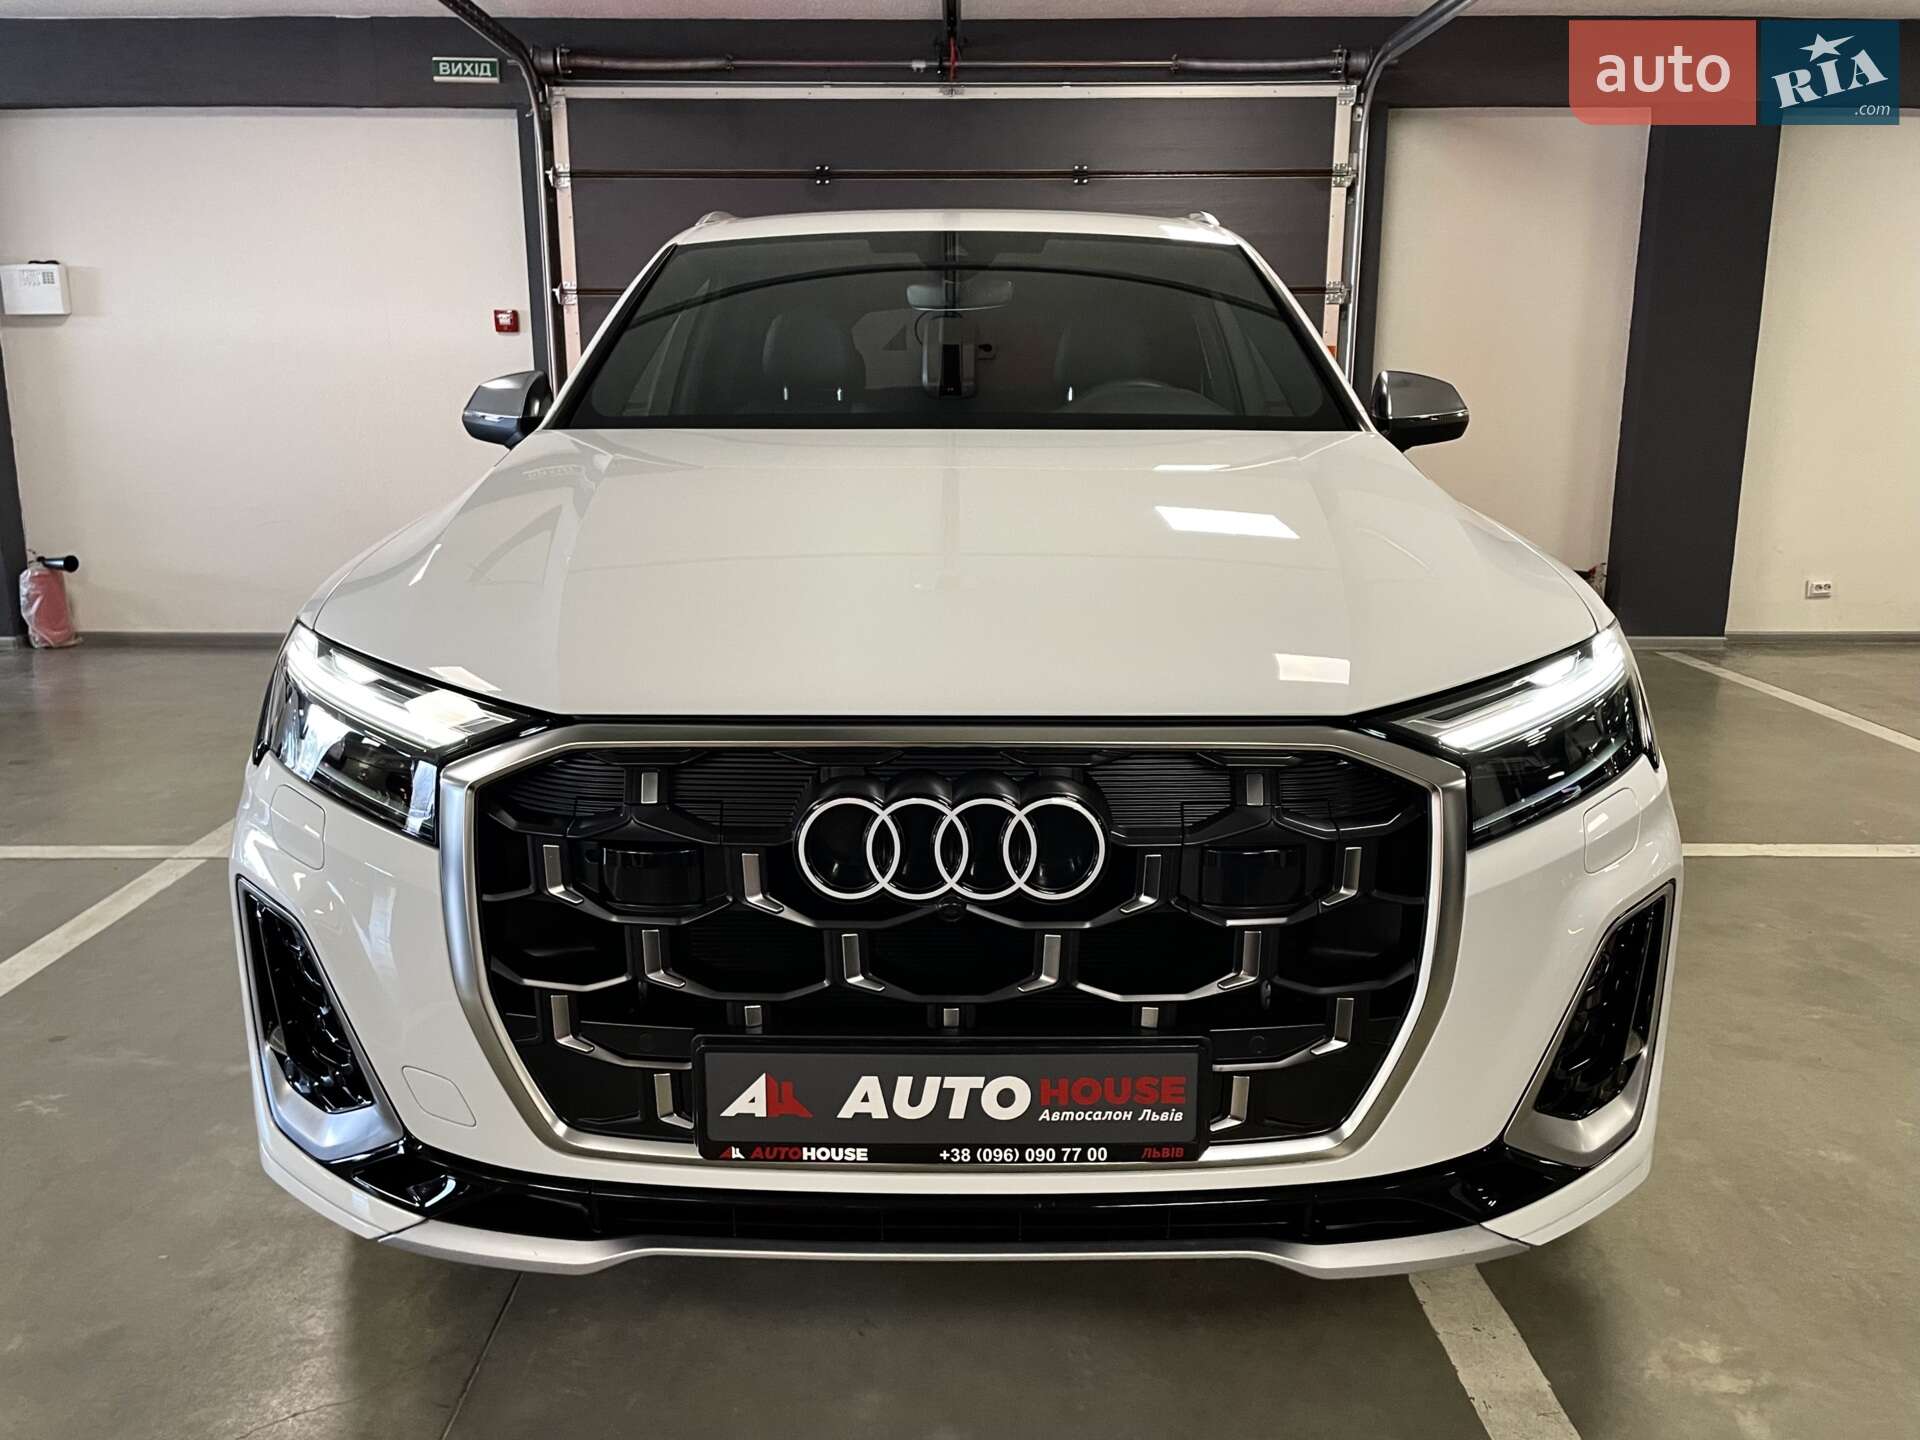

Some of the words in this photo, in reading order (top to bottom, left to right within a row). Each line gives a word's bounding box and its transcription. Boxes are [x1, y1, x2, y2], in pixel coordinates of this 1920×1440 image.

[438, 61, 492, 77] ВИХІД
[836, 1075, 1032, 1121] AUTO
[1040, 1076, 1187, 1106] HOUSE
[1038, 1109, 1133, 1122] Автосалон
[1138, 1108, 1184, 1122] Львів
[939, 1148, 971, 1162] +38
[976, 1148, 1020, 1162] (096)
[1025, 1148, 1056, 1162] 090
[1061, 1148, 1082, 1162] 77
[1087, 1147, 1108, 1161] 00
[1140, 1147, 1185, 1159] ЛЬВІВ
